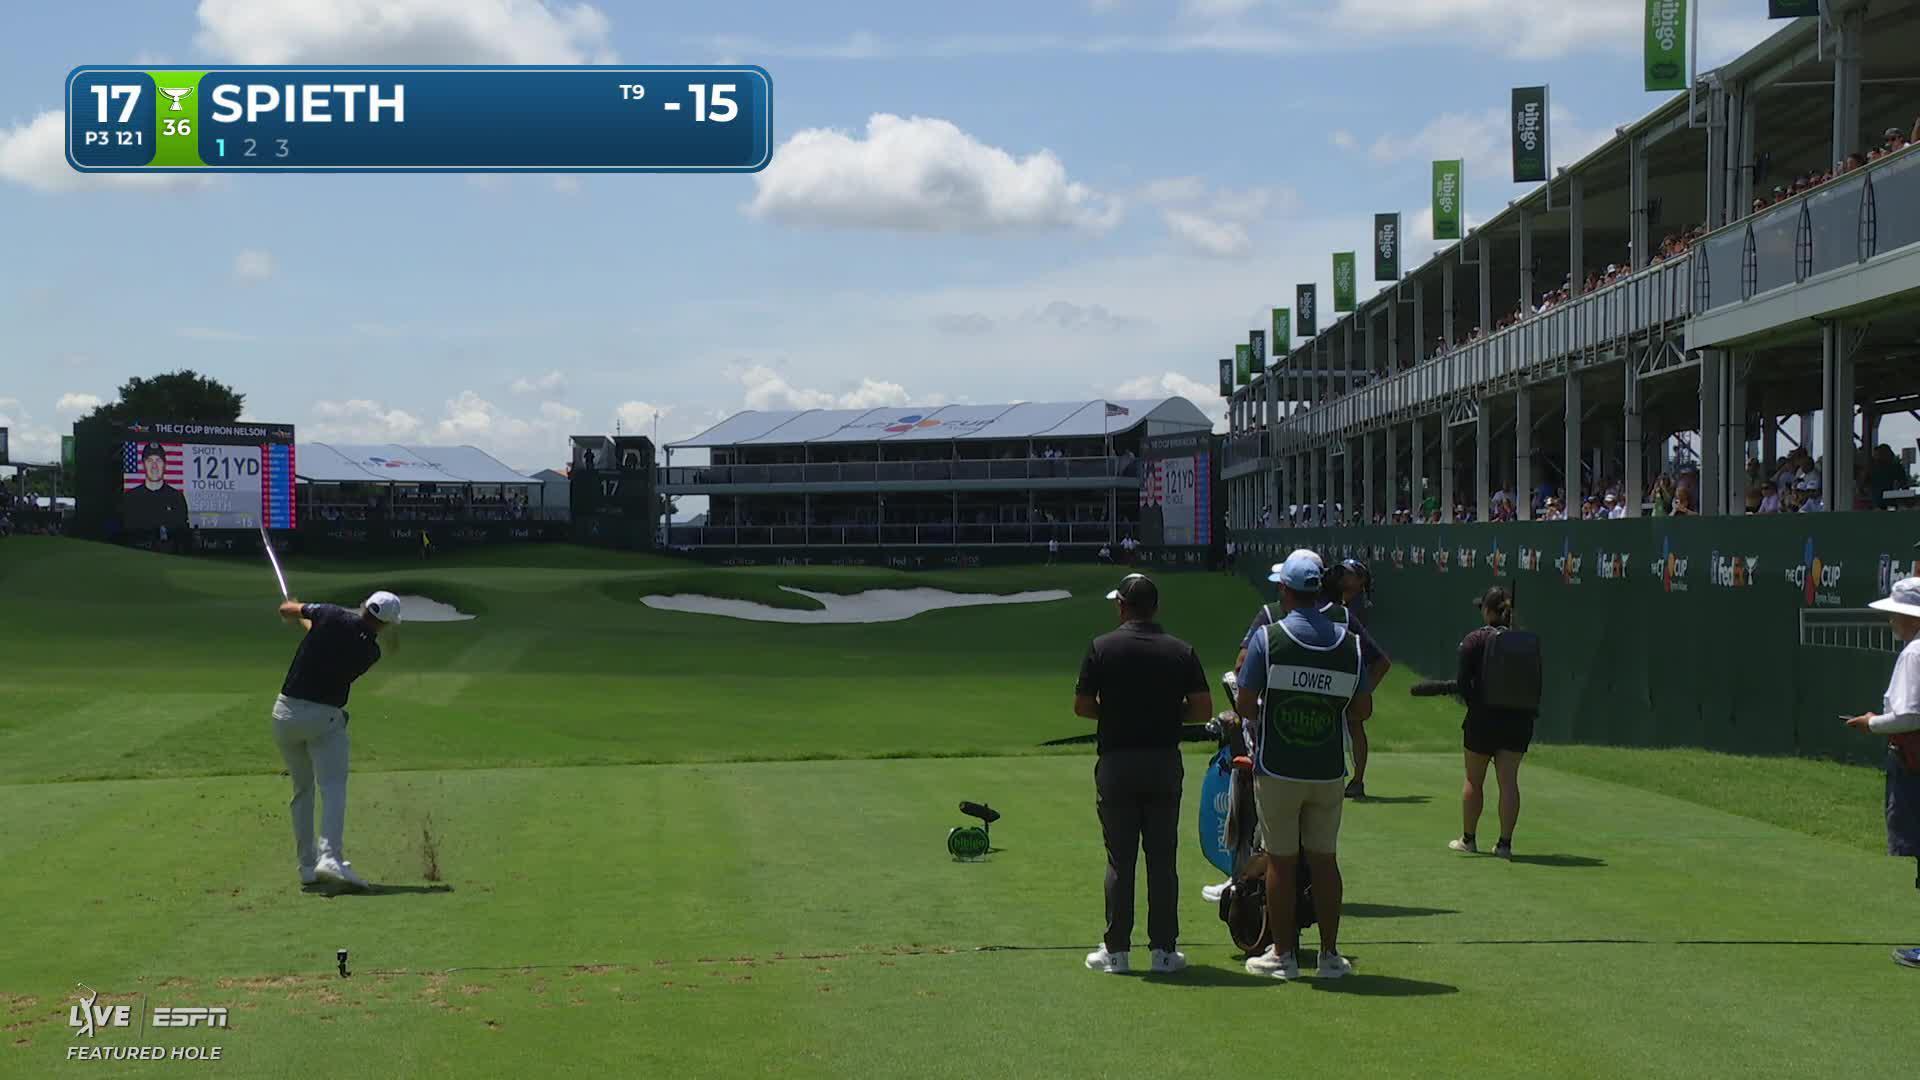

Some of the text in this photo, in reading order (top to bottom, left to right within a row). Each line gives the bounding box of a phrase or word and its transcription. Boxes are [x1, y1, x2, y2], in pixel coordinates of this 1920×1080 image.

[1656, 0, 1680, 50] ibigo
[1520, 102, 1539, 150] bibigo
[155, 423, 172, 433] THE
[204, 425, 233, 436] BYRON
[233, 427, 266, 437] NELSON
[192, 481, 235, 490] TO HOLE
[601, 479, 619, 496] 17
[1795, 564, 1806, 590] CJ
[1821, 564, 1841, 588] CUP
[1292, 671, 1332, 691] LOWER
